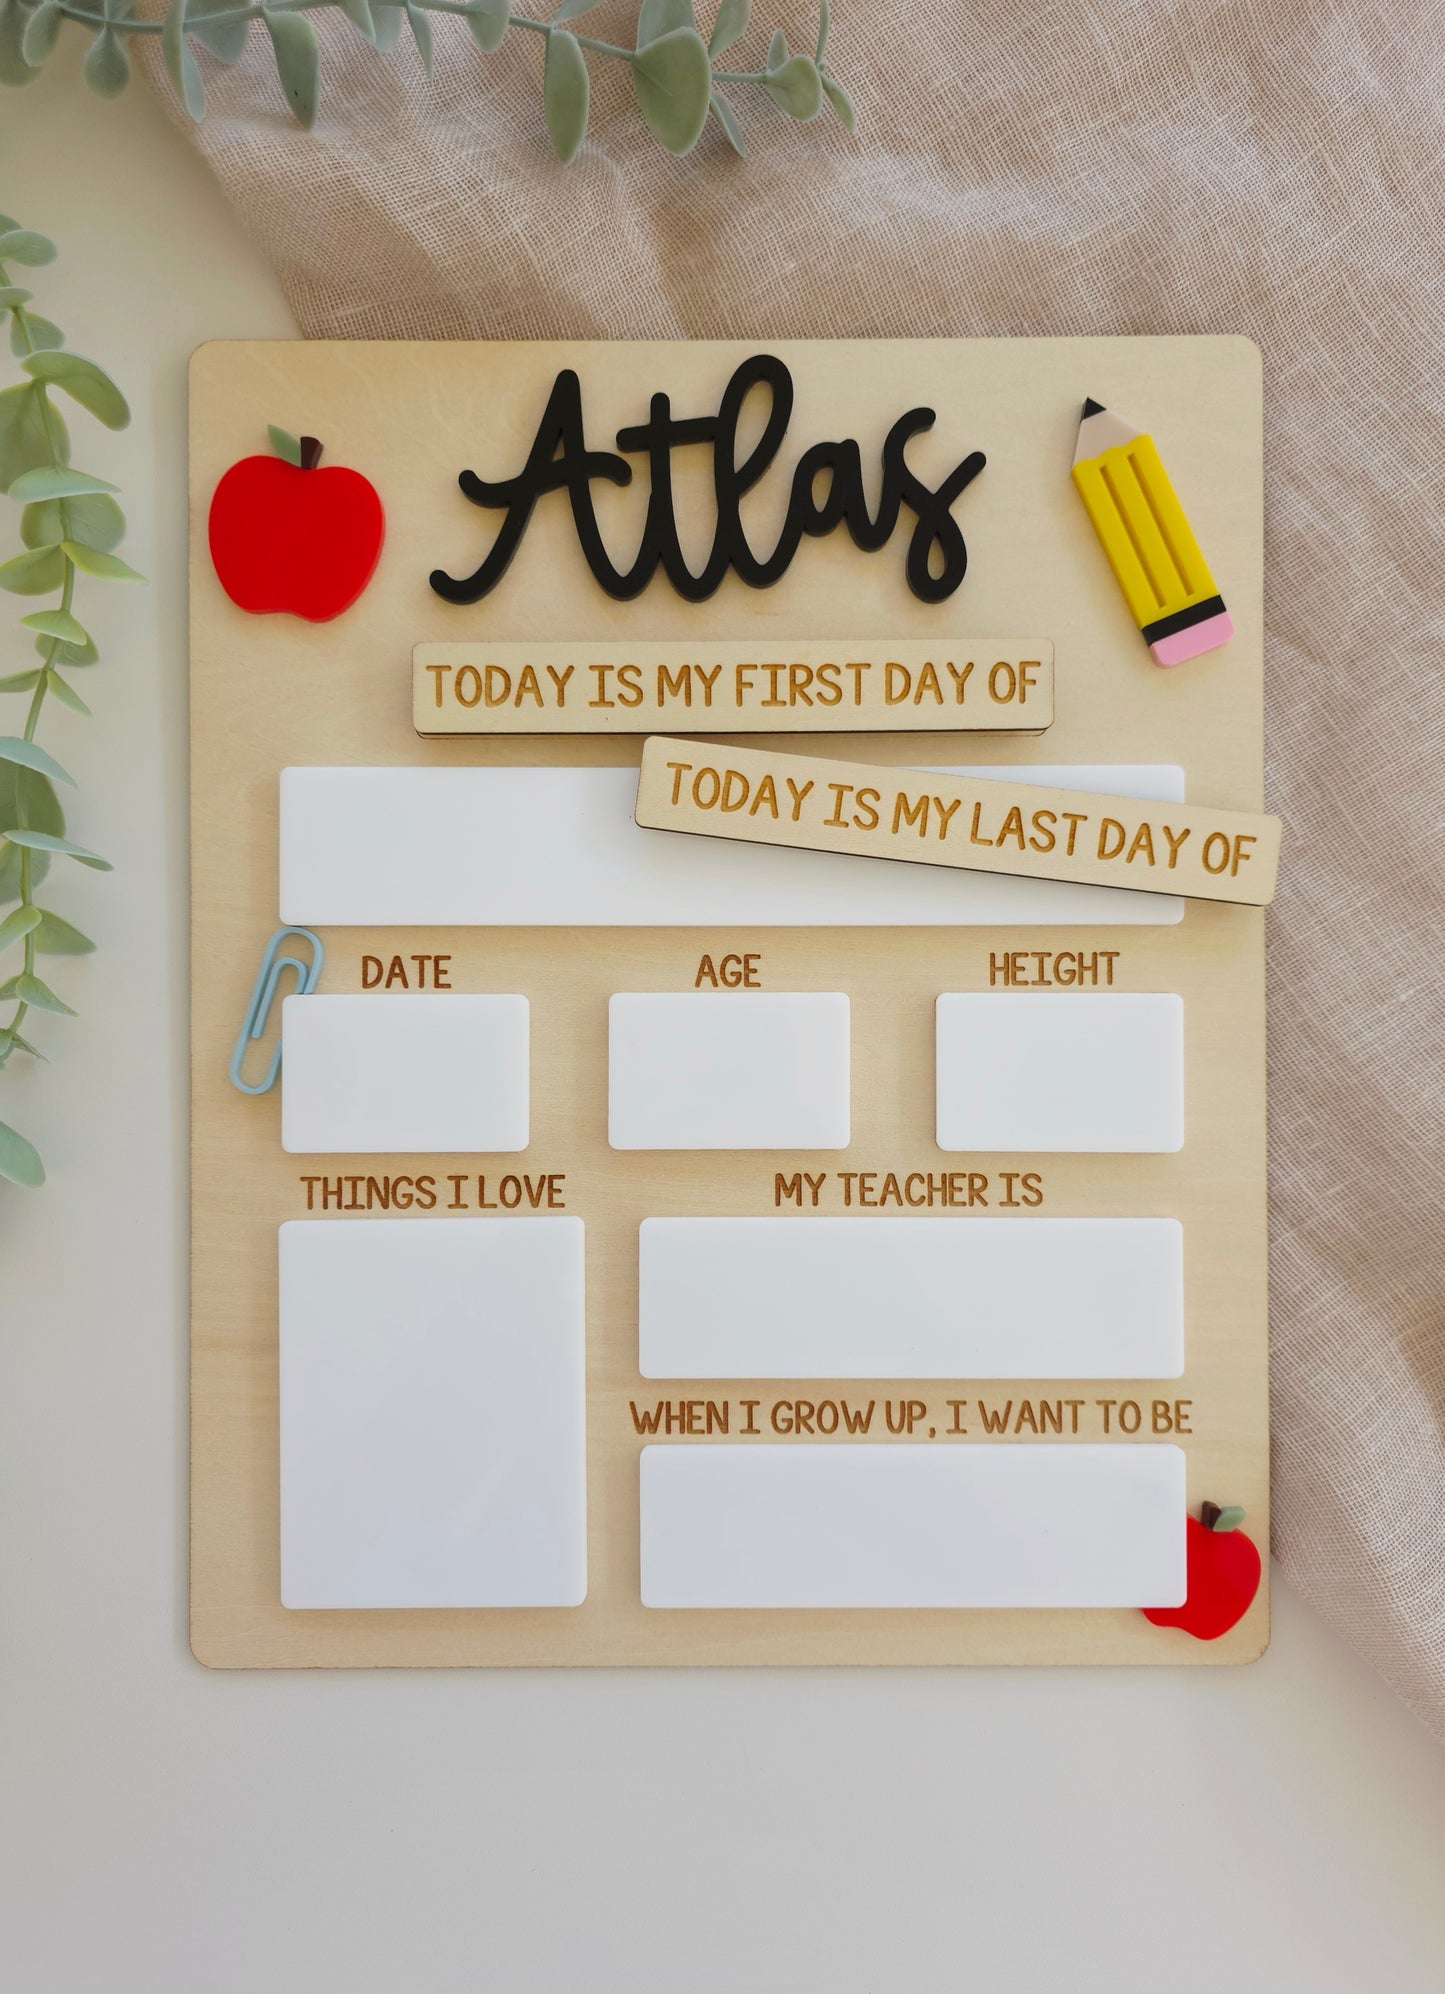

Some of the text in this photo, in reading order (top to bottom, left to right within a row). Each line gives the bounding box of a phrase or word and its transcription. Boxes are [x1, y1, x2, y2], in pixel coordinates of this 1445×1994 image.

[430, 355, 986, 606] Atlas
[425, 661, 1041, 708] TODAY IS MY FIRST DAY OF
[666, 762, 1258, 877] TODAY IS MY LAST DAY OF
[362, 955, 452, 989] DATE
[695, 954, 761, 988] AGE
[990, 951, 1120, 986] HEIGHT
[299, 1174, 565, 1210] THINGS I LOVE
[775, 1173, 1043, 1207] MY TEACHER IS
[629, 1400, 1192, 1438] WHEN I GROW UP, I WANT TO BE
